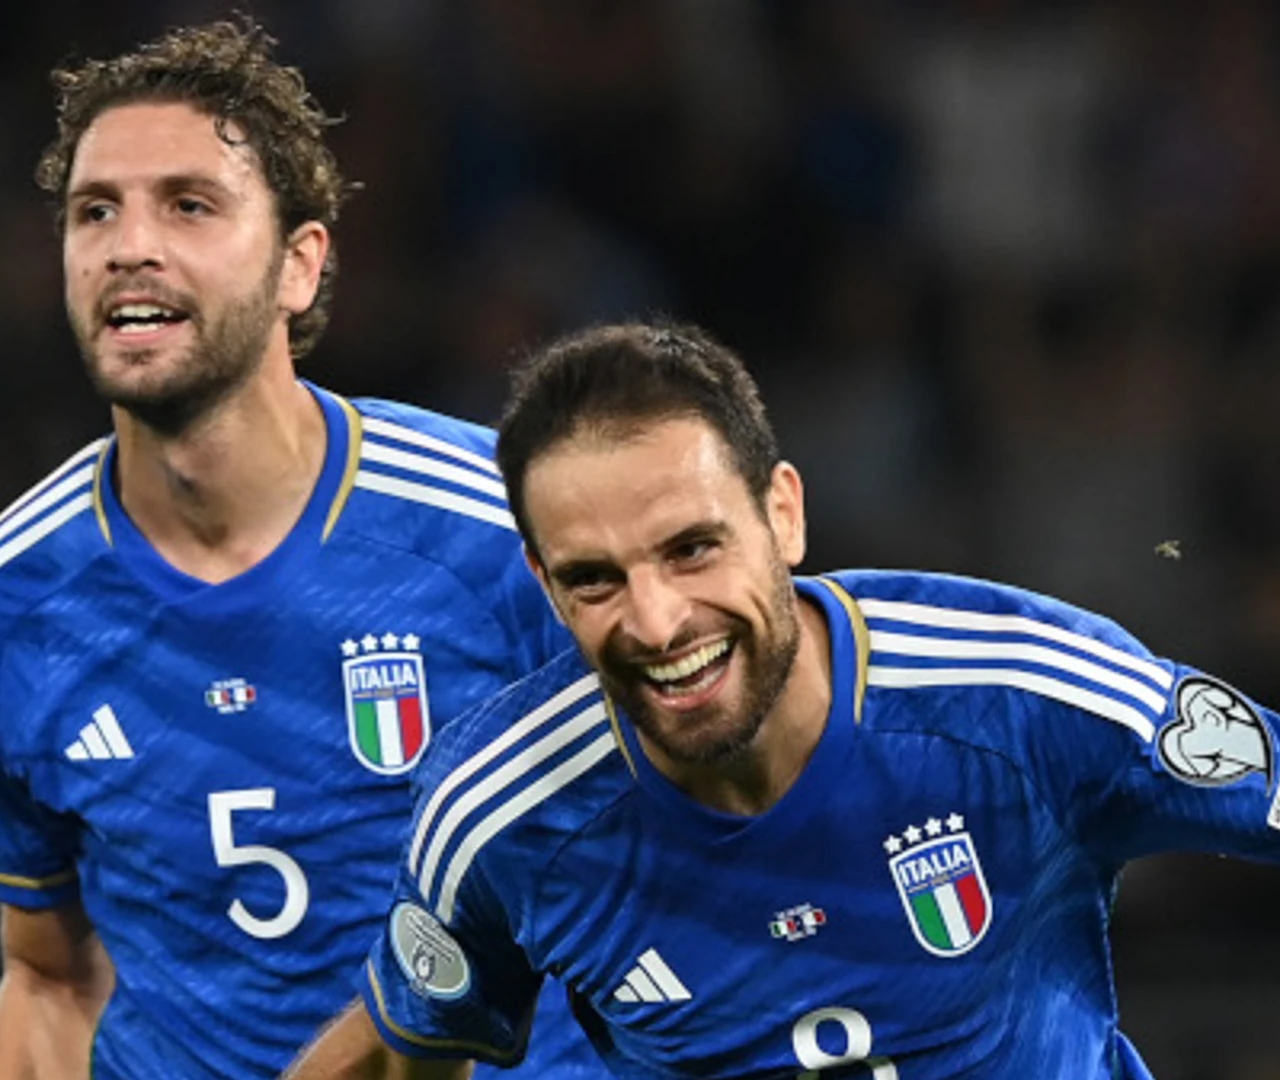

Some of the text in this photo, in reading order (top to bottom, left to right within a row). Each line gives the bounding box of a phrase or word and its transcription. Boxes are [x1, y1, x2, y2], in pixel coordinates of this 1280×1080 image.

[350, 662, 417, 689] ITALIA
[207, 787, 310, 941] 5
[897, 843, 971, 888] ITALIA
